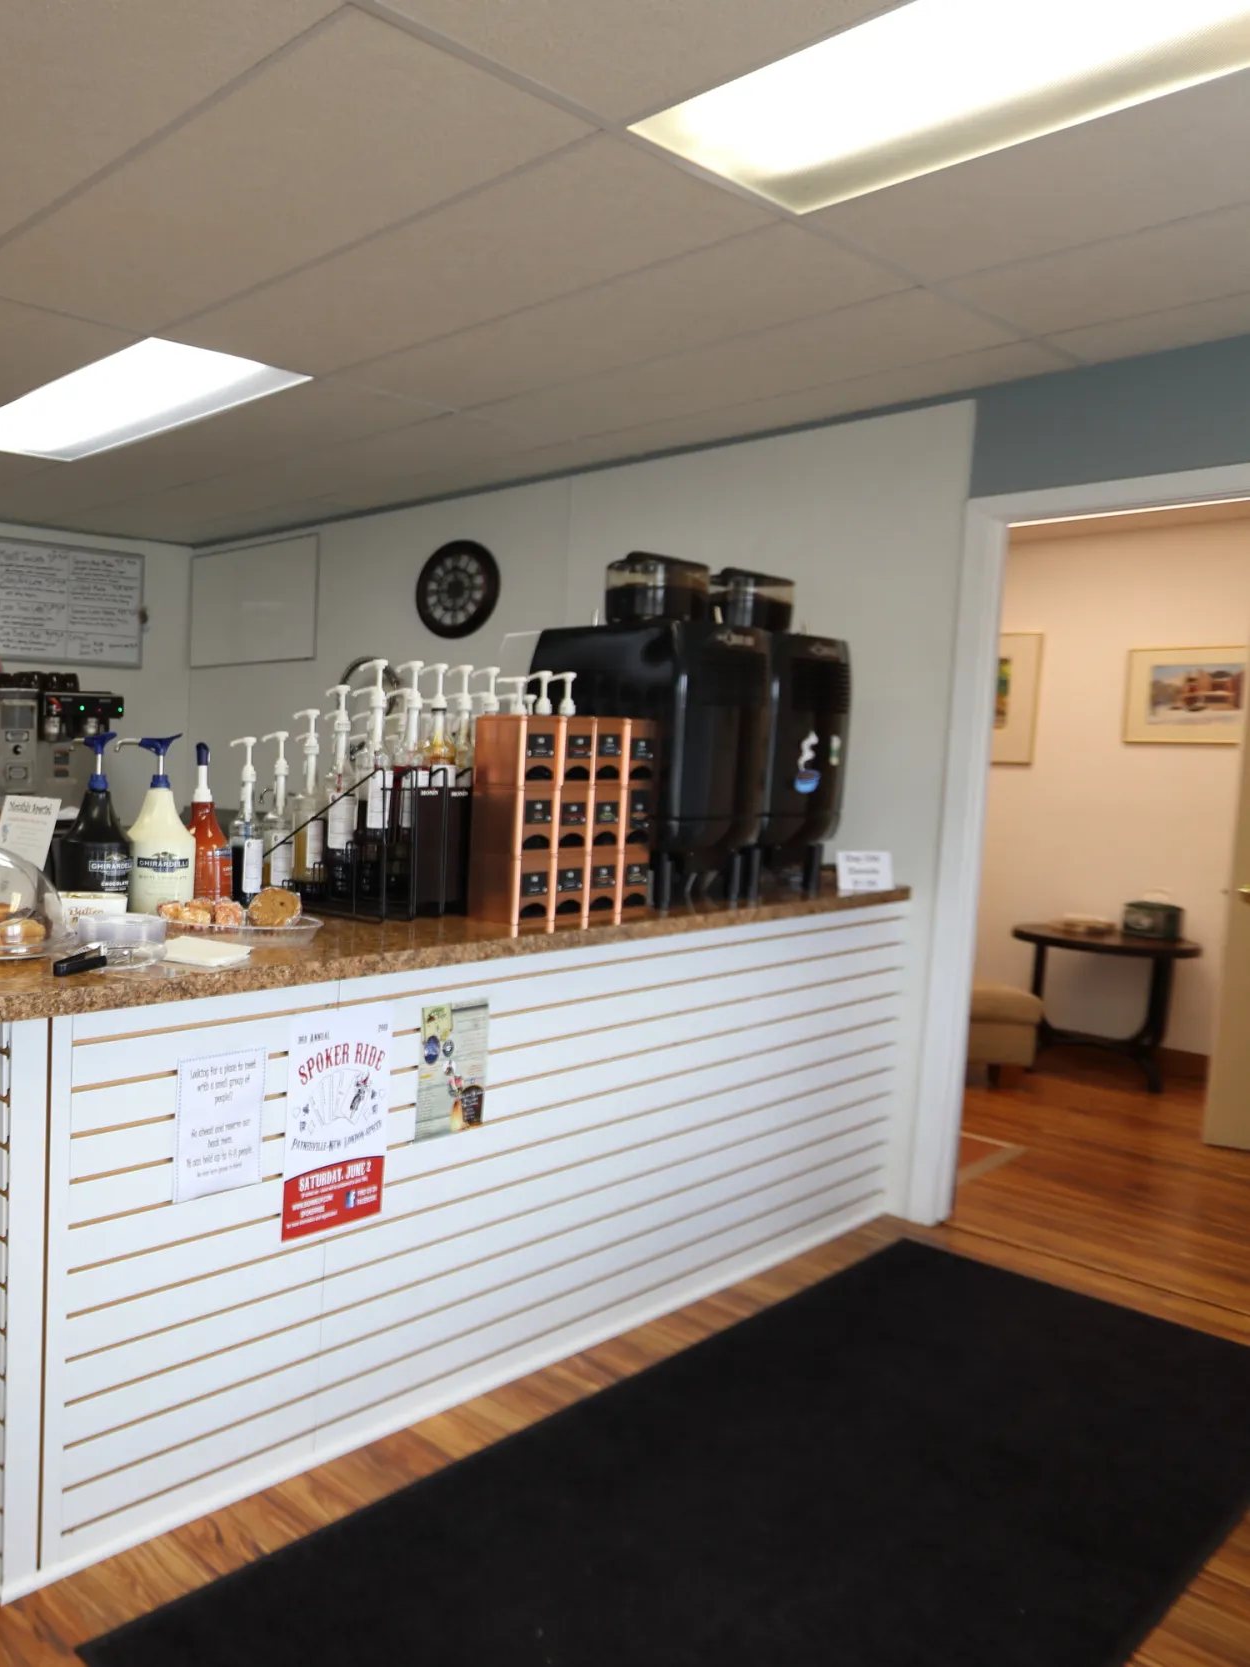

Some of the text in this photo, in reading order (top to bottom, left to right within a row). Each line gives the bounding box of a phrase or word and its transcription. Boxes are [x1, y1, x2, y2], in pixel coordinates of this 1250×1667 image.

[91, 862, 133, 870] GHIRARDELL
[139, 859, 188, 868] GHIRARDELLI
[224, 1063, 237, 1076] place
[298, 1042, 386, 1086] SPOKER RIDE
[214, 1092, 234, 1106] people?
[345, 1161, 366, 1180] JUNE
[366, 1161, 372, 1173] 2
